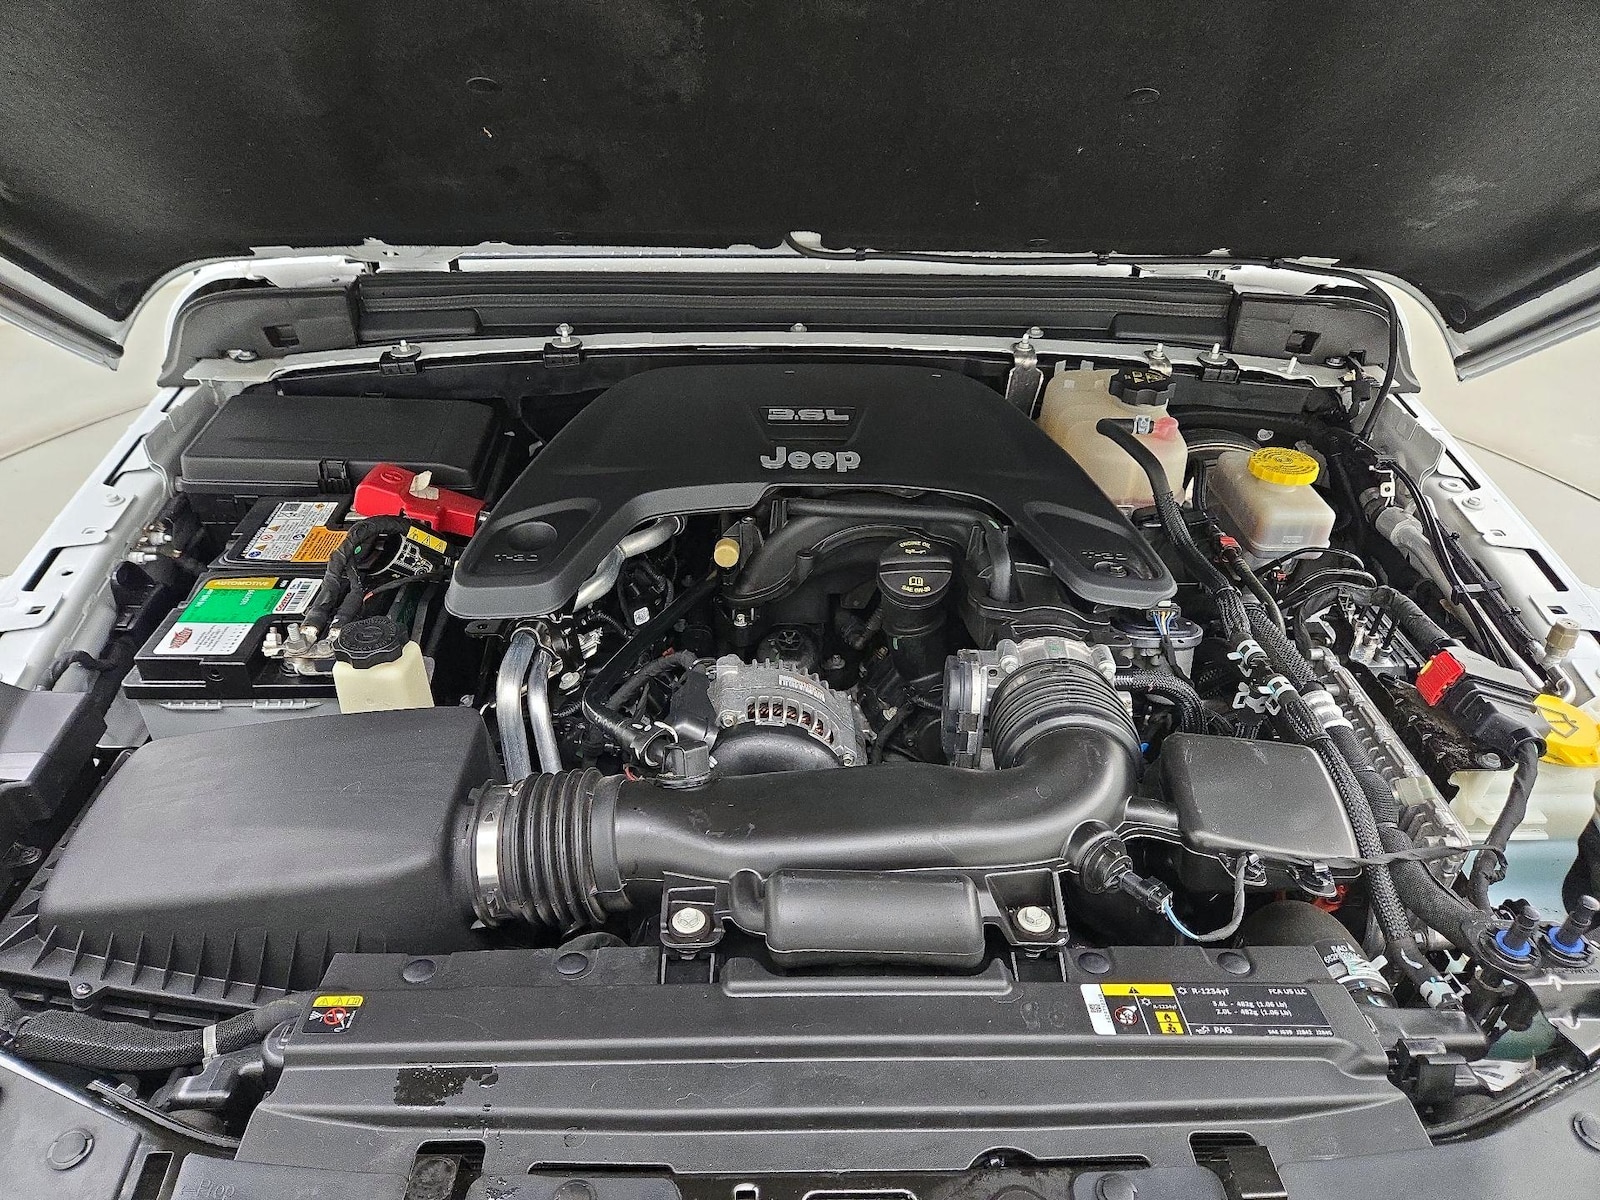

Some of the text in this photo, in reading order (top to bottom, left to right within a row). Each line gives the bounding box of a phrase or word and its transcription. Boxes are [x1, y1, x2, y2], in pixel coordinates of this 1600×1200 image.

[768, 409, 849, 420] 3.6L
[760, 447, 860, 472] Jeep
[275, 592, 293, 612] COSTCO
[1191, 988, 1230, 996] R-1234yf
